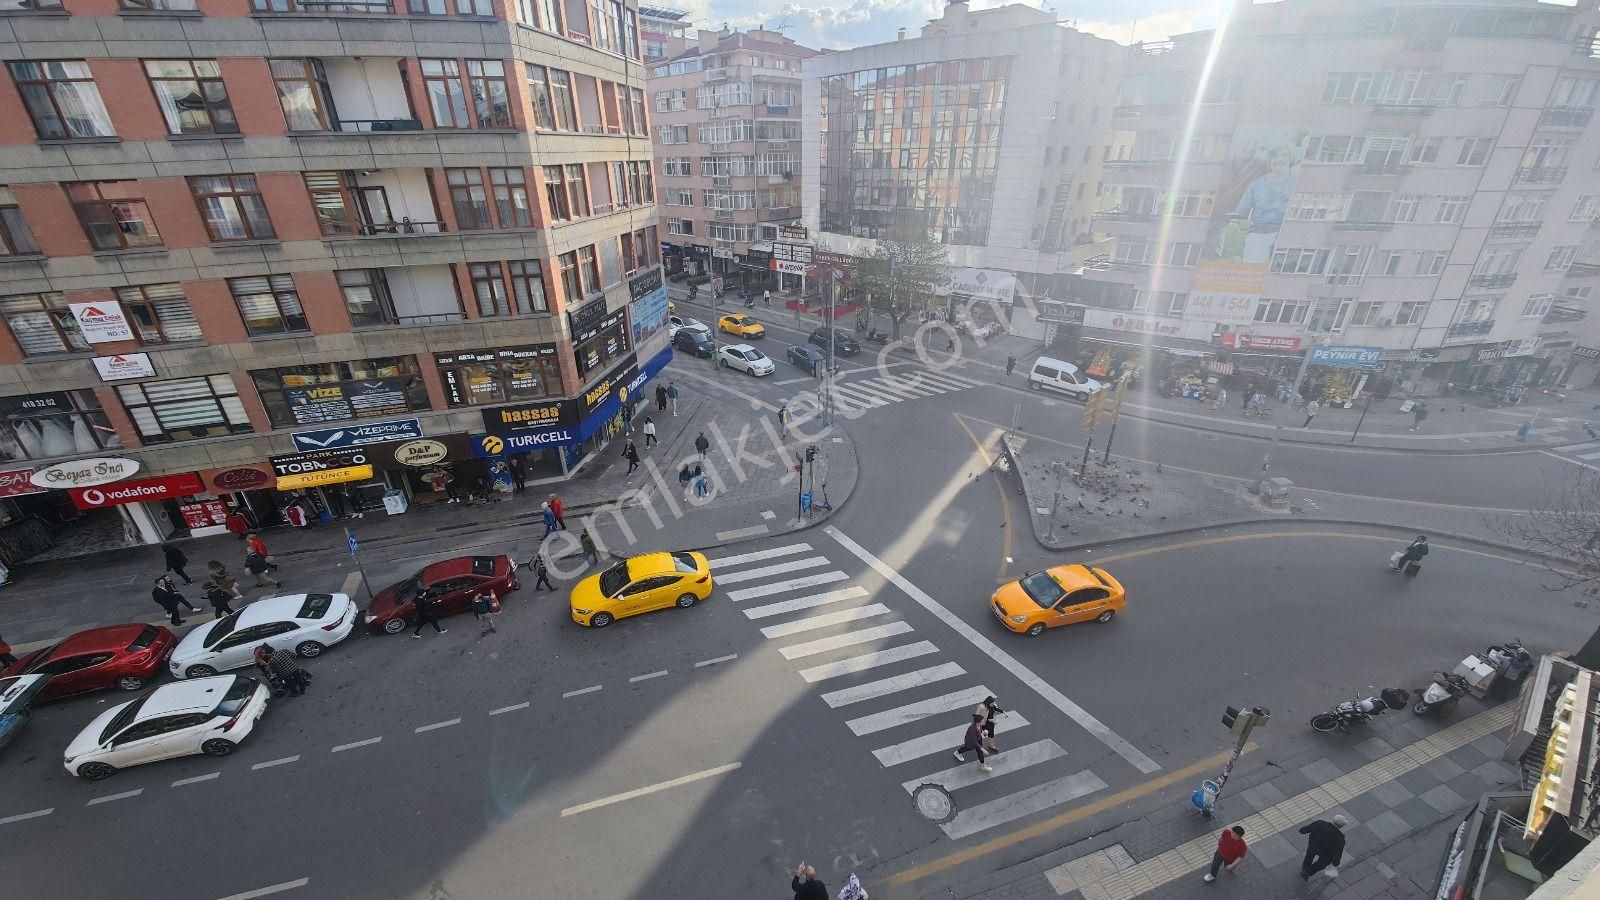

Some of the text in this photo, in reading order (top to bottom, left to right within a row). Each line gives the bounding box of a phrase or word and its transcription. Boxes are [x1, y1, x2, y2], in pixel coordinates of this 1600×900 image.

[307, 387, 342, 399] VİZE
[447, 371, 460, 403] EMLAK
[501, 405, 559, 423] hassas
[507, 430, 572, 448] TURKCELL
[306, 451, 332, 459] PARK
[408, 445, 431, 455] D&P
[276, 454, 366, 475] TOBACCO
[106, 483, 167, 500] vodafone
